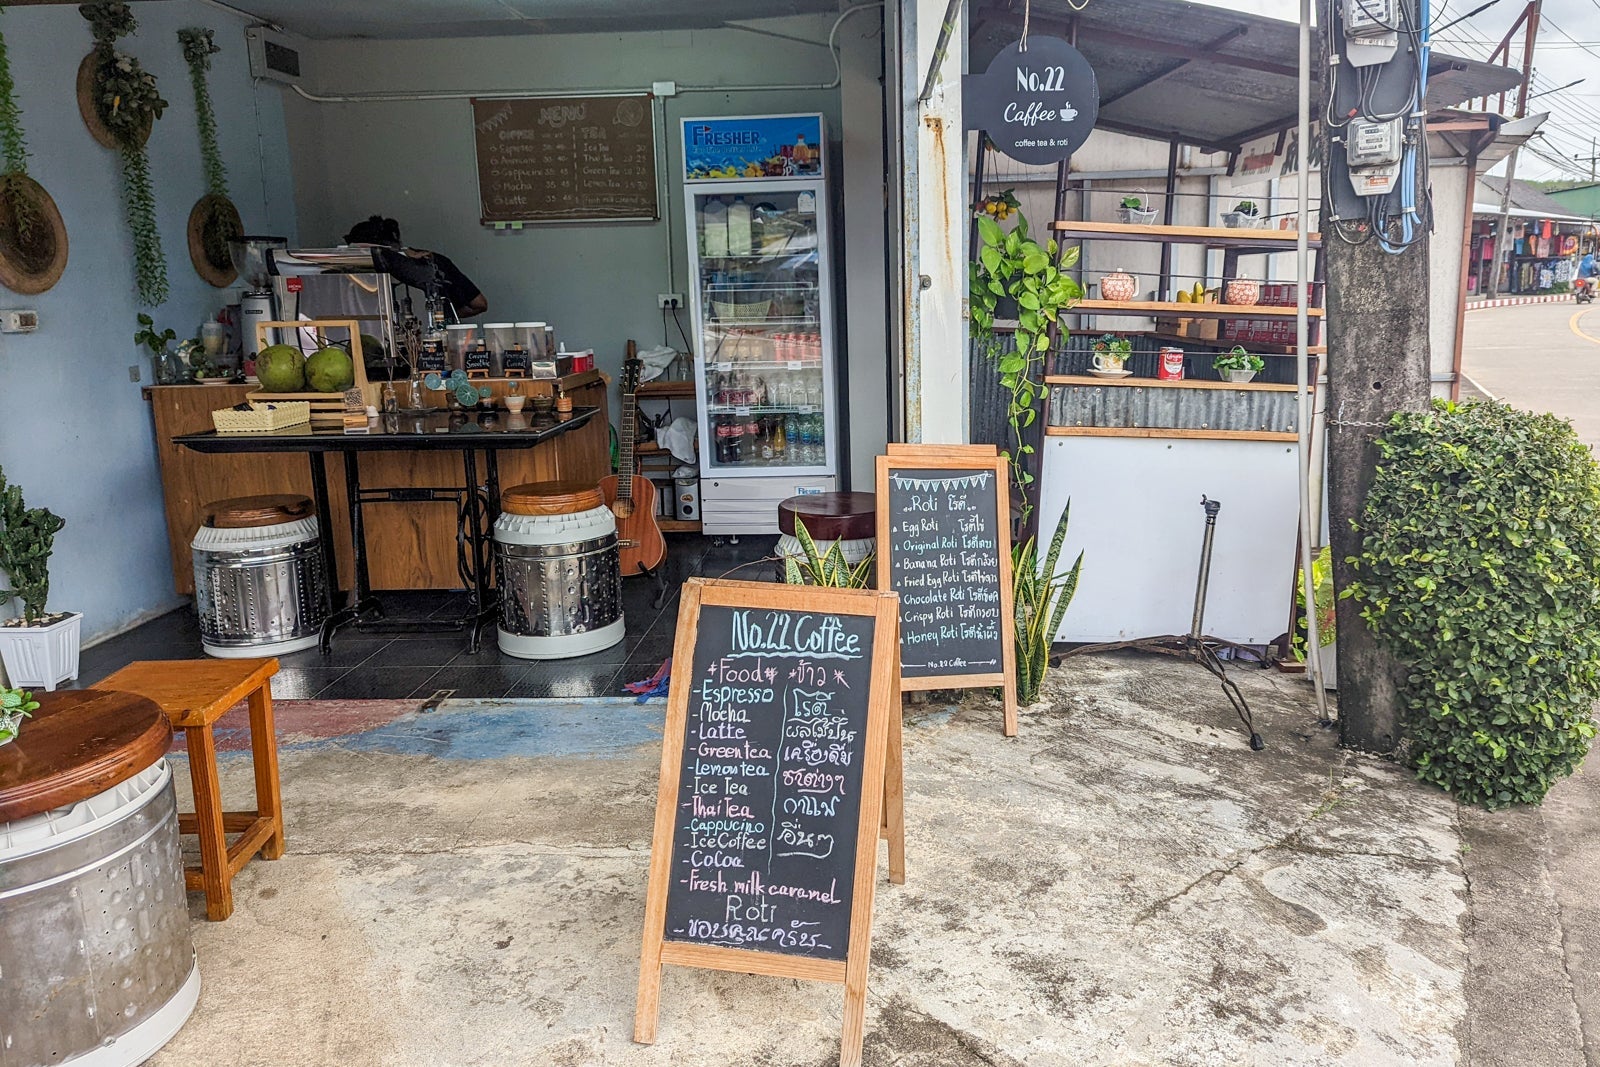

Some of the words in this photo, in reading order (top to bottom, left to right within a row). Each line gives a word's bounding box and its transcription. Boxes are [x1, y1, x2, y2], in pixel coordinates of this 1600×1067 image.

[1016, 66, 1065, 92] No.22
[538, 102, 586, 127] MENU
[692, 125, 760, 146] FRESHER
[1014, 139, 1036, 147] coffee
[1037, 139, 1048, 147] tea
[1049, 138, 1056, 146] &
[1057, 138, 1068, 146] roti
[583, 166, 607, 176] Green
[911, 495, 938, 511] Roti
[948, 494, 967, 511] โรตี
[902, 521, 919, 537] Egg
[921, 518, 938, 531] Roti
[903, 536, 939, 555] Original
[941, 535, 958, 549] Roti
[903, 557, 938, 570] Banana
[940, 553, 956, 567] Roti
[904, 574, 925, 587] Fried
[927, 574, 942, 589] Egg
[943, 569, 959, 584] Roti
[904, 590, 947, 605] Chocolate
[950, 585, 965, 602] Roti
[904, 611, 934, 627] Crispy
[936, 605, 953, 620] Roti
[957, 604, 999, 619] โรตีกรอบ
[732, 610, 791, 651] No.22
[794, 615, 862, 654] Coffee
[907, 630, 939, 647] Honey
[940, 625, 958, 640] Roti
[718, 658, 764, 683] Food
[796, 659, 827, 687] ข้าว
[927, 660, 948, 668] No.22
[702, 679, 774, 709] Espresso
[792, 688, 836, 717] โรตี
[700, 702, 751, 723] Mocha
[699, 722, 747, 739] Latte
[694, 777, 717, 795] Ice
[724, 777, 749, 795] Tea
[692, 795, 721, 818] Thai
[724, 797, 755, 818] Tea
[691, 832, 715, 848] Ice
[717, 832, 767, 850] Coffee
[689, 869, 727, 893] Fresh
[734, 871, 765, 896] milk
[768, 878, 842, 904] caramel
[726, 894, 778, 923] Roti
